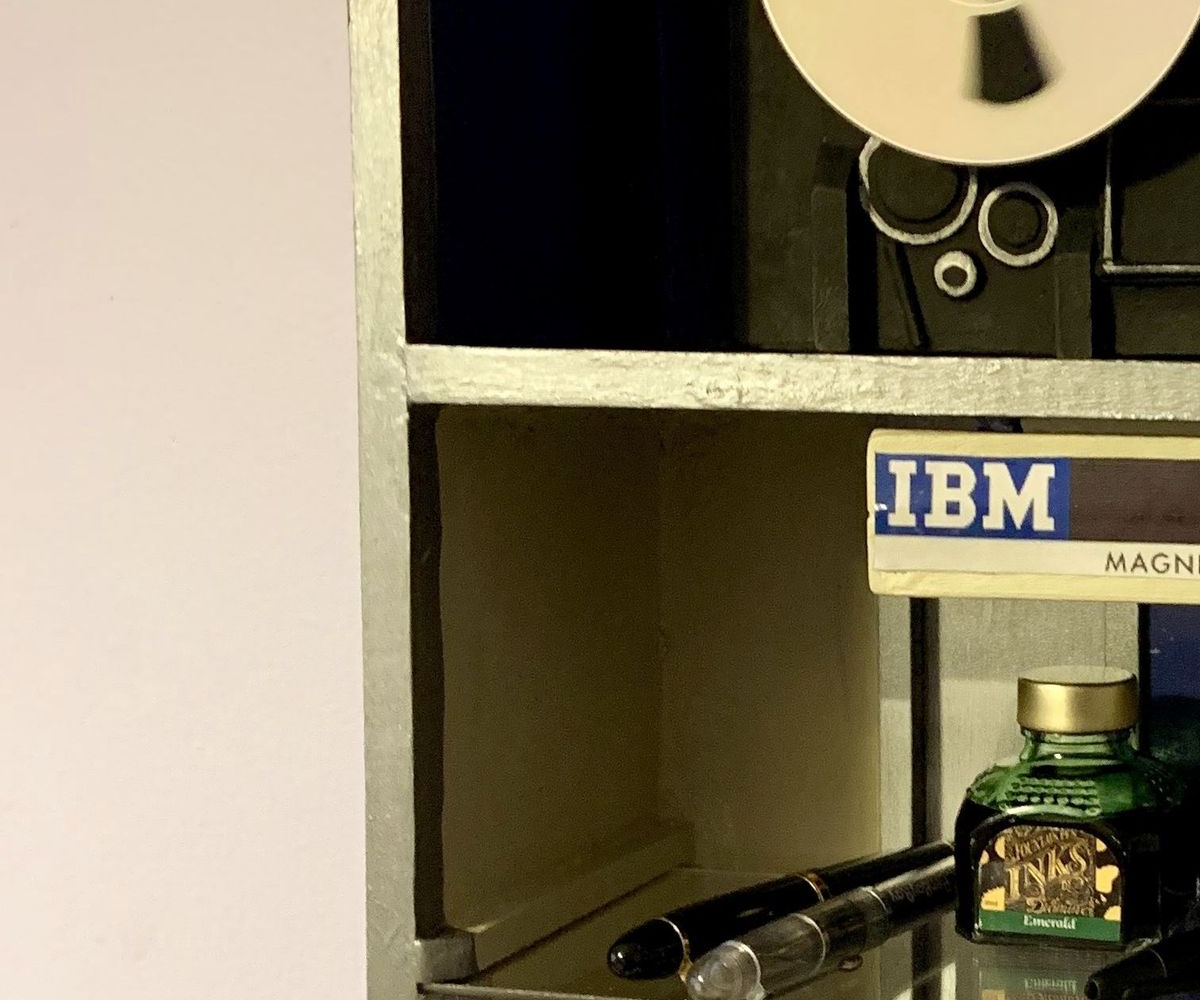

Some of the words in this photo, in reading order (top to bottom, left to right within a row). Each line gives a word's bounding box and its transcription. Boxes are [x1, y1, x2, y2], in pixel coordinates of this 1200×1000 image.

[888, 460, 1055, 531] IBM
[1006, 846, 1087, 899] INKS
[1023, 914, 1078, 930] Emerald
